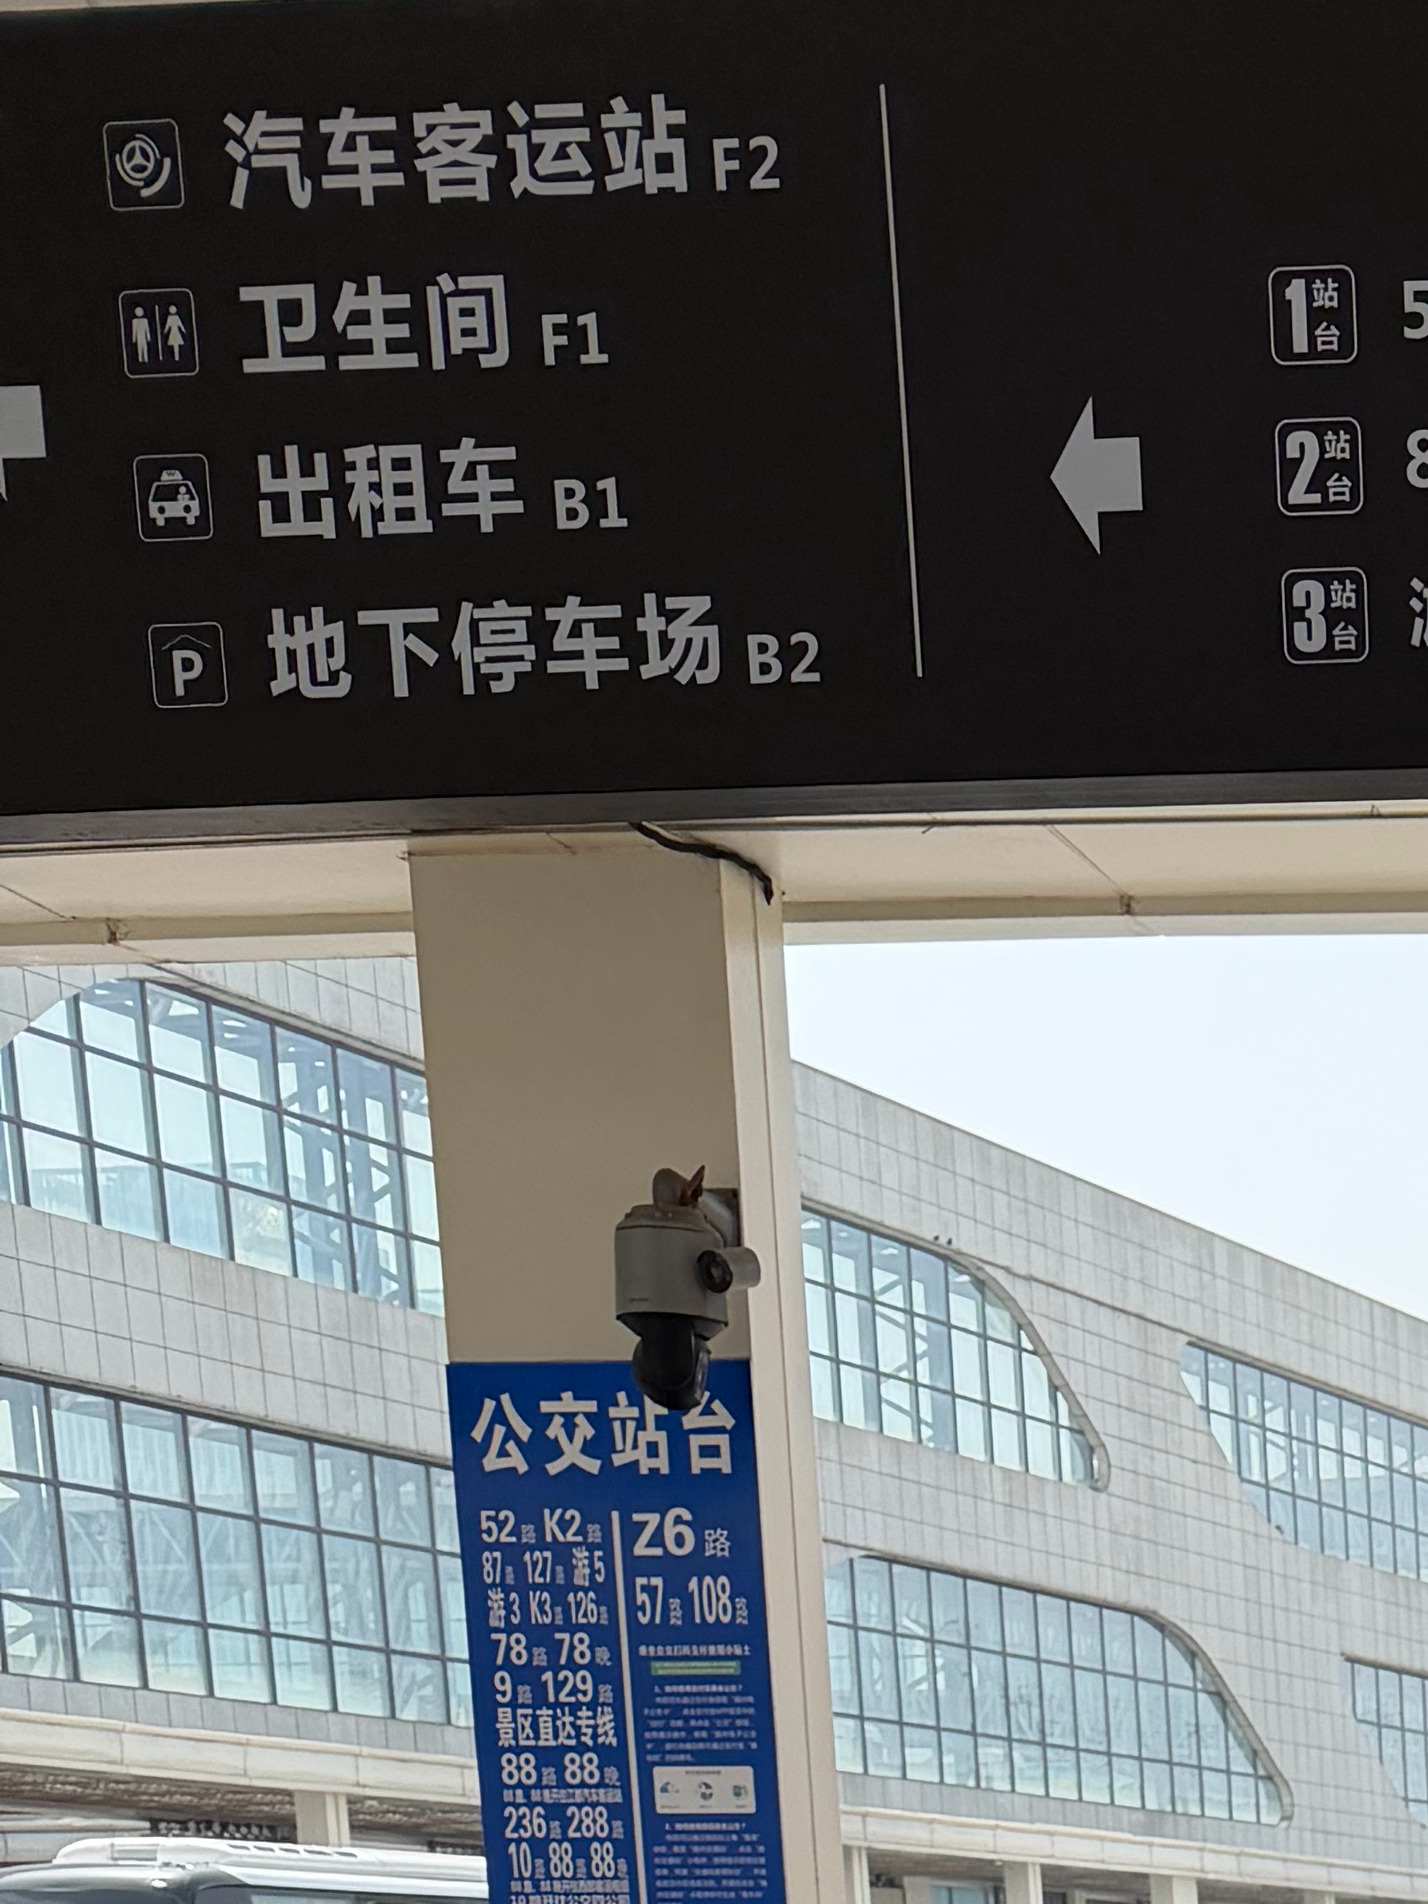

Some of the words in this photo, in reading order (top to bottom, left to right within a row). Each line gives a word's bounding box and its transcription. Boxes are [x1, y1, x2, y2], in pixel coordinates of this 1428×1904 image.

[223, 92, 689, 209] 汽车客运站
[712, 137, 780, 190] F2
[239, 274, 510, 374] 卫生间
[542, 312, 609, 366] F1
[256, 436, 523, 539] 出租车
[555, 476, 627, 531] B1
[267, 592, 720, 700] 地下停车场
[746, 633, 821, 685] B2
[472, 1390, 736, 1475] 公交站台
[496, 1706, 617, 1747] 景区直达专线
